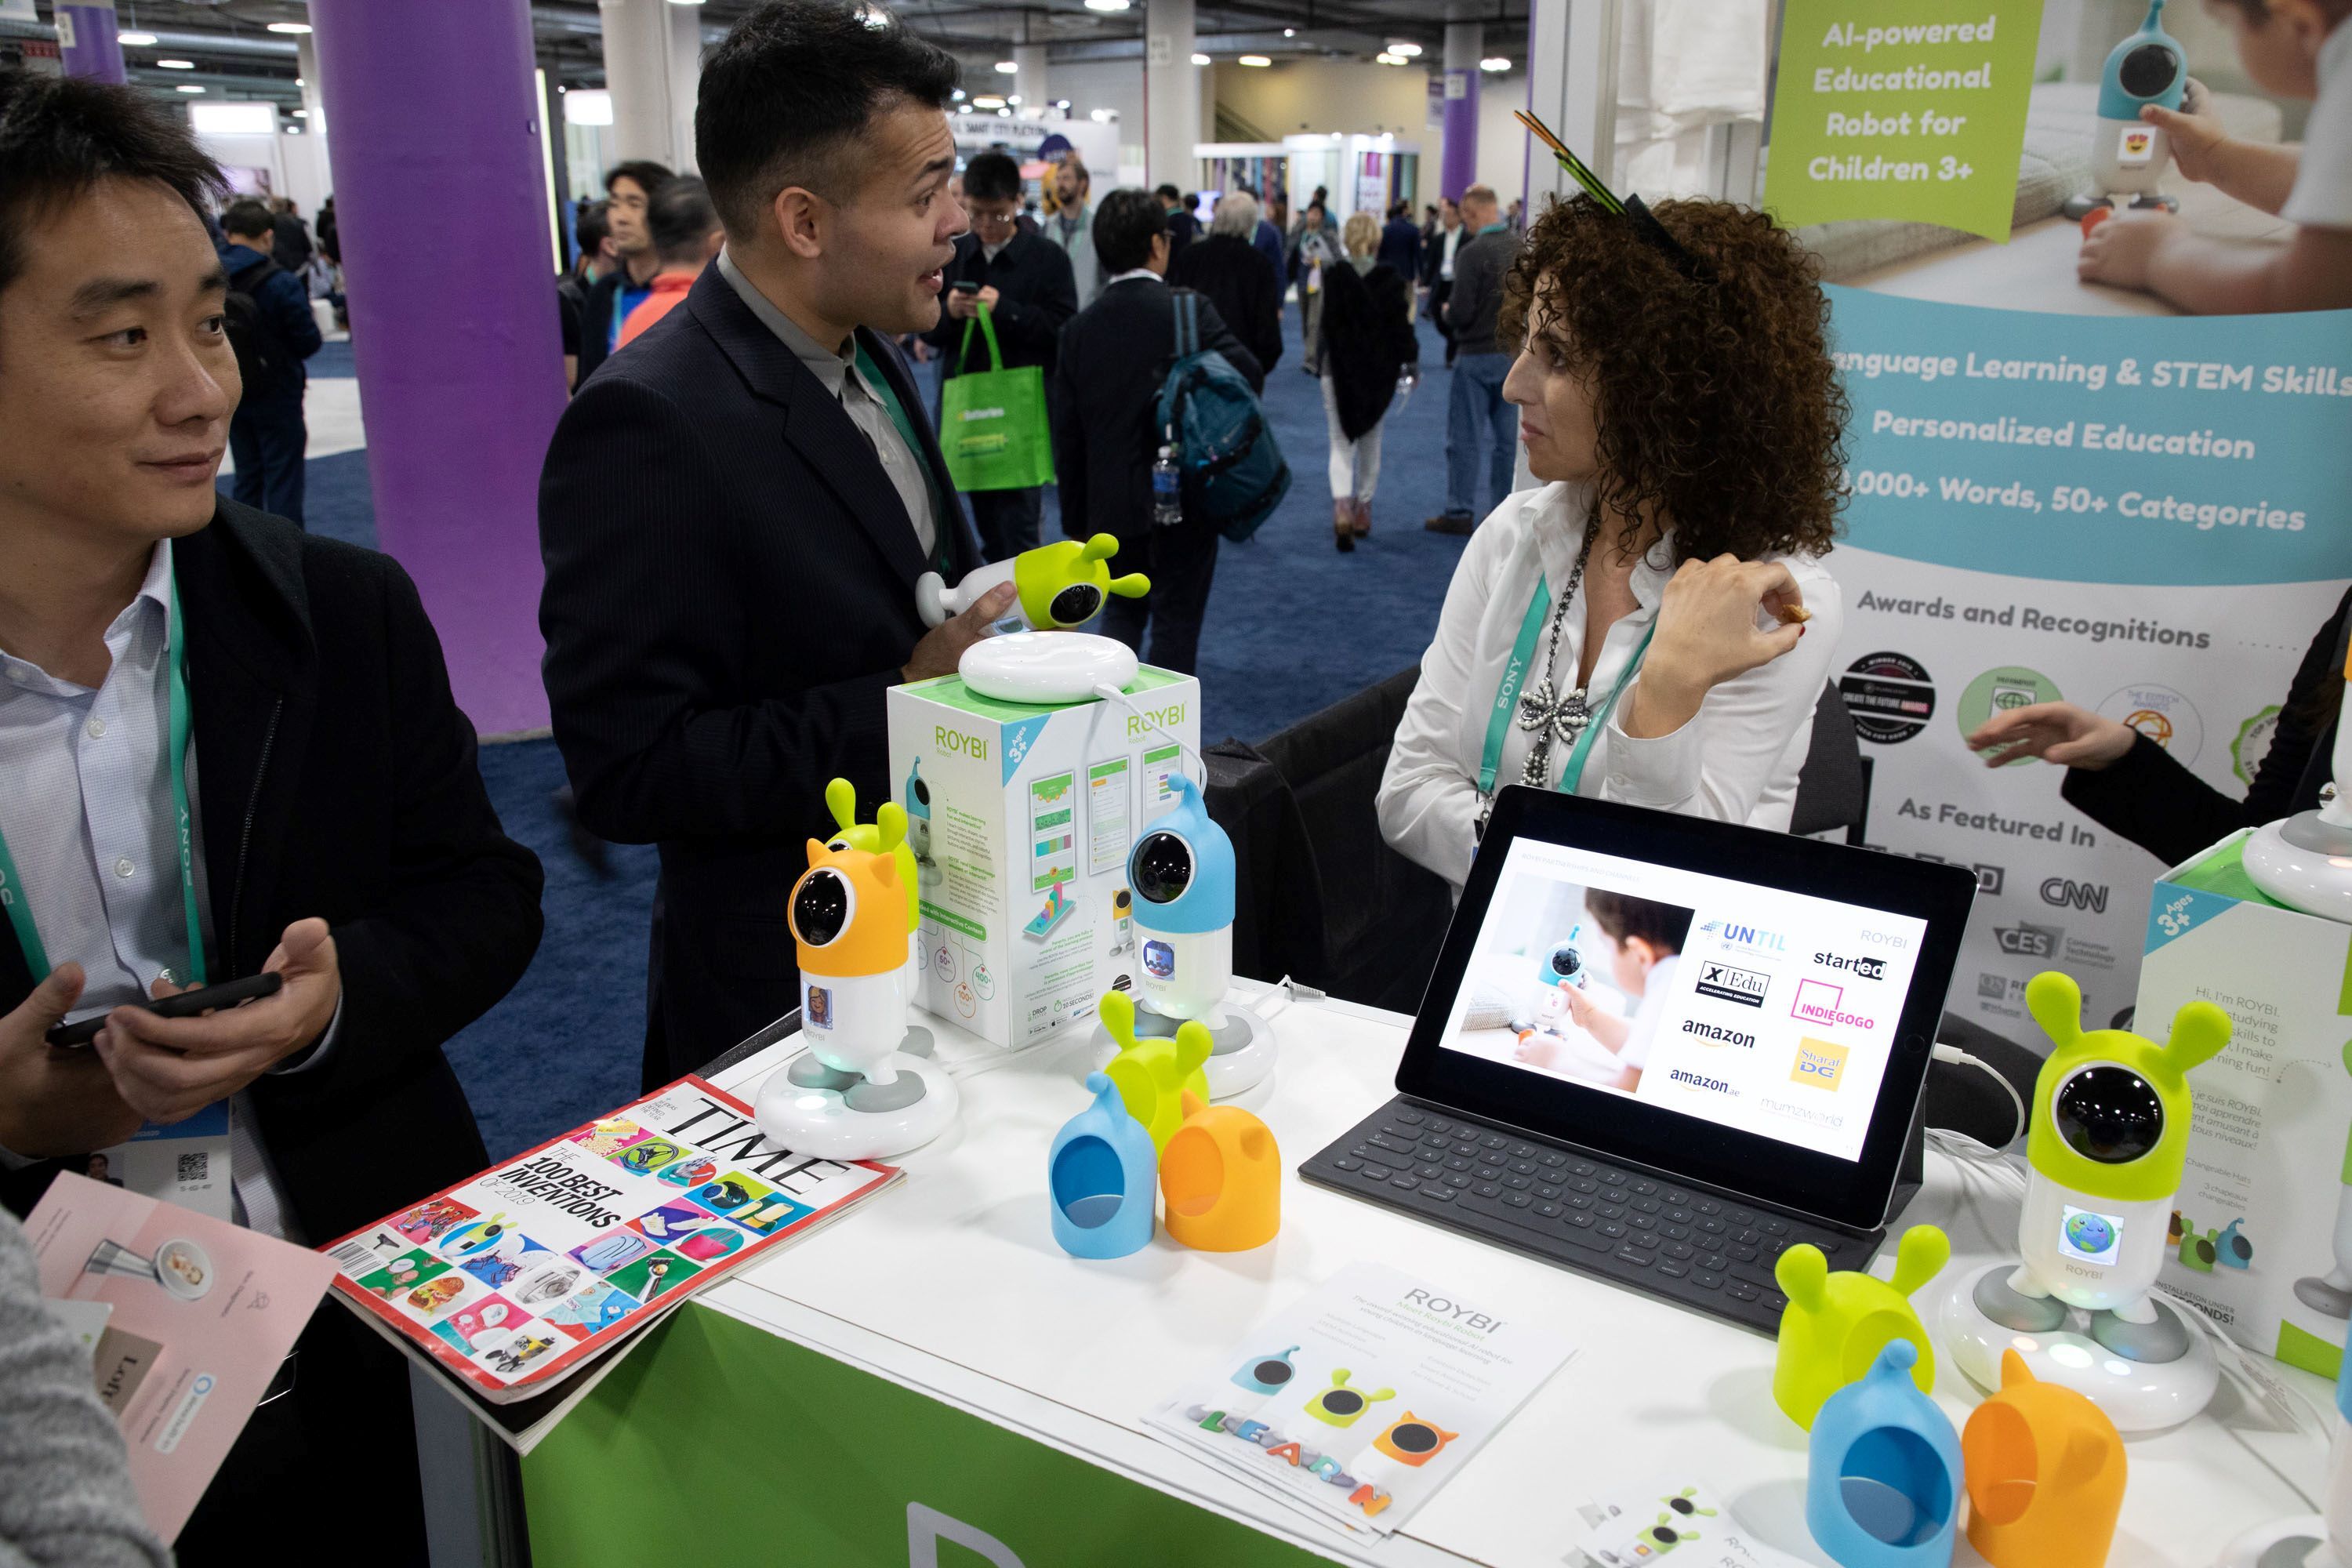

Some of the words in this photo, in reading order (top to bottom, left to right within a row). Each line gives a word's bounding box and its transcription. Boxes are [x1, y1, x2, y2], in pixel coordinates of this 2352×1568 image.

[1821, 14, 1996, 53] AI-powered
[1813, 62, 1991, 93] Educational
[1826, 111, 1913, 136] Robot
[1919, 110, 1966, 136] for
[1808, 154, 1929, 182] Children
[1936, 154, 1973, 182] 3+
[1830, 351, 1958, 382] anguage
[1965, 351, 2108, 390] Learning
[2115, 358, 2142, 386] &
[2151, 361, 2254, 391] STEM
[1872, 409, 2075, 448] Personalized
[2082, 423, 2256, 460] Education
[1938, 475, 2043, 514] Words,
[2051, 485, 2109, 514] 50+
[2118, 491, 2307, 531] Categories
[1857, 590, 1955, 620] Awards
[1962, 604, 2016, 627] and
[2021, 607, 2211, 650] Recognitions
[1497, 655, 1523, 710] SONY
[1127, 702, 1185, 737] ROYBI
[935, 724, 988, 761] ROYBI
[1011, 726, 1027, 747] Ages
[1007, 741, 1028, 764] 3+
[1897, 797, 1931, 821] As
[1937, 802, 2064, 844] Featured
[2070, 825, 2096, 848] In
[2039, 877, 2110, 915] CNN
[2166, 894, 2194, 916] Ages
[930, 908, 940, 917] with
[940, 913, 964, 929] Interactive
[964, 923, 984, 936] Content
[2157, 912, 2190, 937] 3+
[1723, 922, 1787, 952] UNTIL
[1859, 929, 1908, 950] ROYBI
[2001, 928, 2049, 956] CES
[1704, 966, 1725, 982] X
[1728, 971, 1764, 993] Edu
[1813, 951, 1888, 980] started
[1699, 985, 1733, 998] ACCELERATING
[1733, 993, 1761, 1005] EDUCATION
[2195, 985, 2212, 1000] Hi,
[2214, 990, 2234, 1005] I'm
[1032, 1006, 1047, 1017] DROP
[1800, 1003, 1875, 1030] INDIEGOGO
[2227, 1010, 2279, 1035] studying
[1681, 1018, 1756, 1049] amazon
[2231, 1026, 2259, 1044] skills
[2262, 1033, 2276, 1047] to
[1799, 1048, 1842, 1068] Sharaf
[2241, 1046, 2274, 1062] make
[2245, 1061, 2271, 1077] fun!
[1759, 1096, 1844, 1128] mumzworld
[2206, 1093, 2226, 1106] suis
[2205, 1116, 2252, 1138] amusant
[2209, 1106, 2263, 1129] apprendre
[662, 1097, 851, 1196] TIME
[2191, 1124, 2214, 1138] tous
[2214, 1131, 2259, 1151] niveaux!
[548, 1145, 584, 1163] THE
[522, 1156, 574, 1181] 100
[557, 1173, 624, 1203] BEST
[2184, 1156, 2232, 1178] Changeable
[2231, 1169, 2252, 1185] Hats
[479, 1178, 507, 1189] OF
[495, 1185, 536, 1207] 2019
[497, 1167, 622, 1229] INVENTIONS
[2198, 1189, 2247, 1212] changeables
[2210, 1184, 2249, 1203] chapeaux
[2064, 1263, 2105, 1281] ROYBI
[1403, 1287, 1502, 1334] ROYBI
[2207, 1297, 2236, 1316] UNDER
[1352, 1294, 1367, 1305] The
[1479, 1346, 1501, 1361] robot
[1501, 1356, 1514, 1365] for
[1395, 1300, 1424, 1317] Meet
[1423, 1311, 1454, 1329] Roybi
[1453, 1323, 1486, 1342] Robot
[1382, 1312, 1417, 1334] children
[1422, 1330, 1458, 1352] language
[1458, 1346, 1491, 1365] learning
